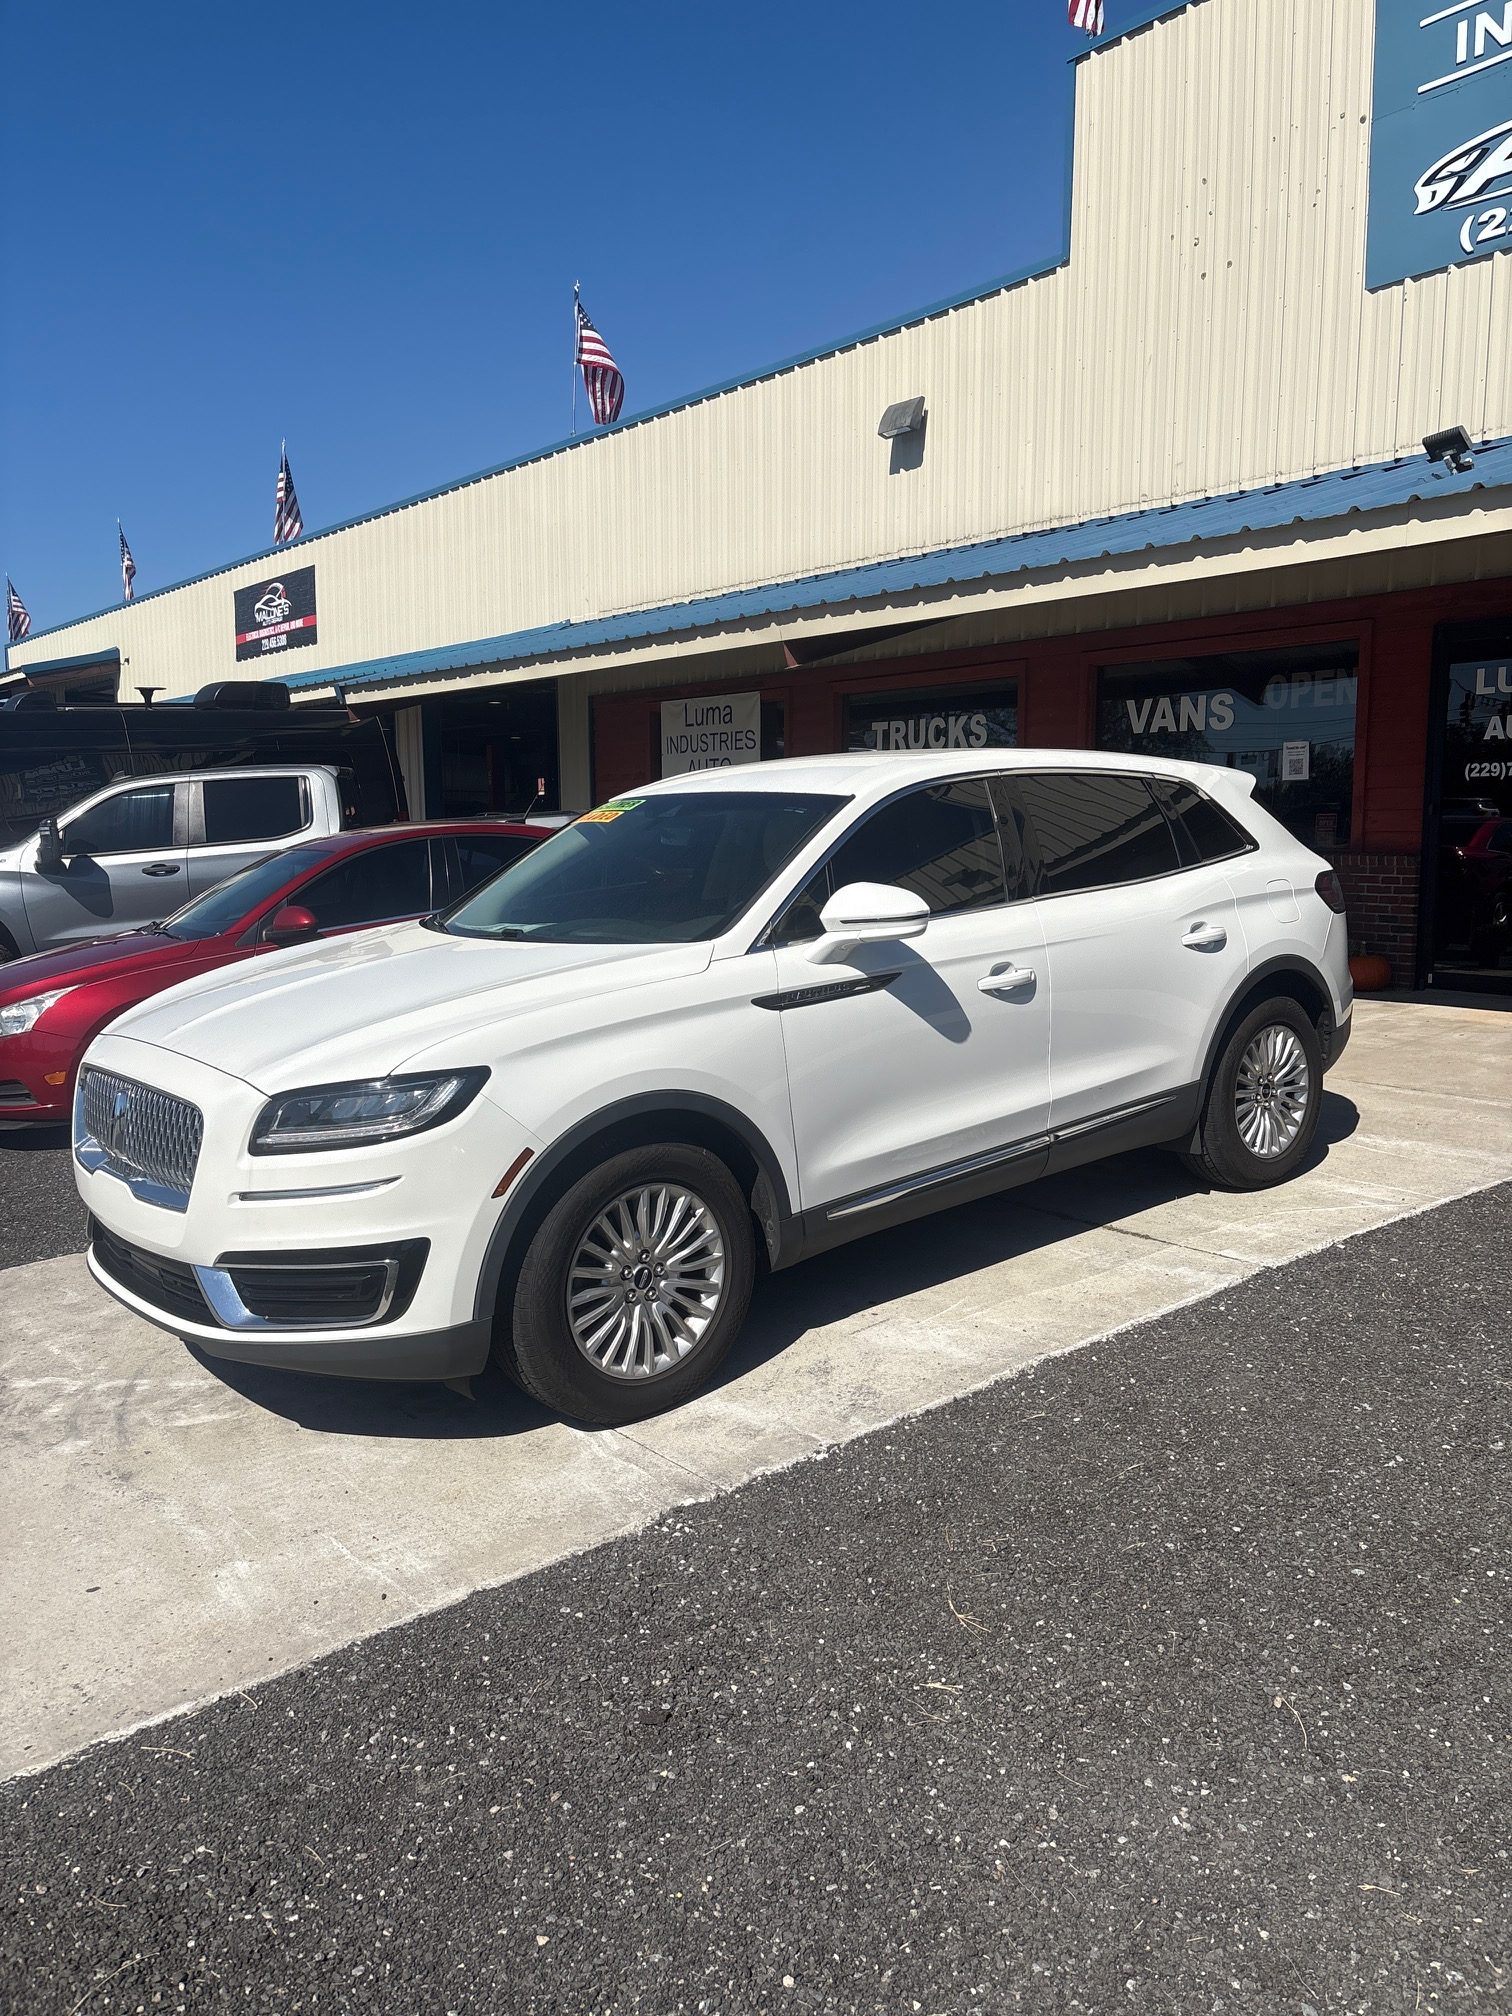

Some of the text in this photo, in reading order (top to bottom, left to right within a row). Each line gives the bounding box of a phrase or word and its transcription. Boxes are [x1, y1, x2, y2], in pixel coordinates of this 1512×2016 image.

[1459, 206, 1512, 254] (2
[684, 702, 733, 728] Luma
[1126, 693, 1235, 734] VANS
[1483, 714, 1512, 740] A
[666, 730, 756, 755] INDUSTRIES
[871, 714, 988, 750] TRUCKS
